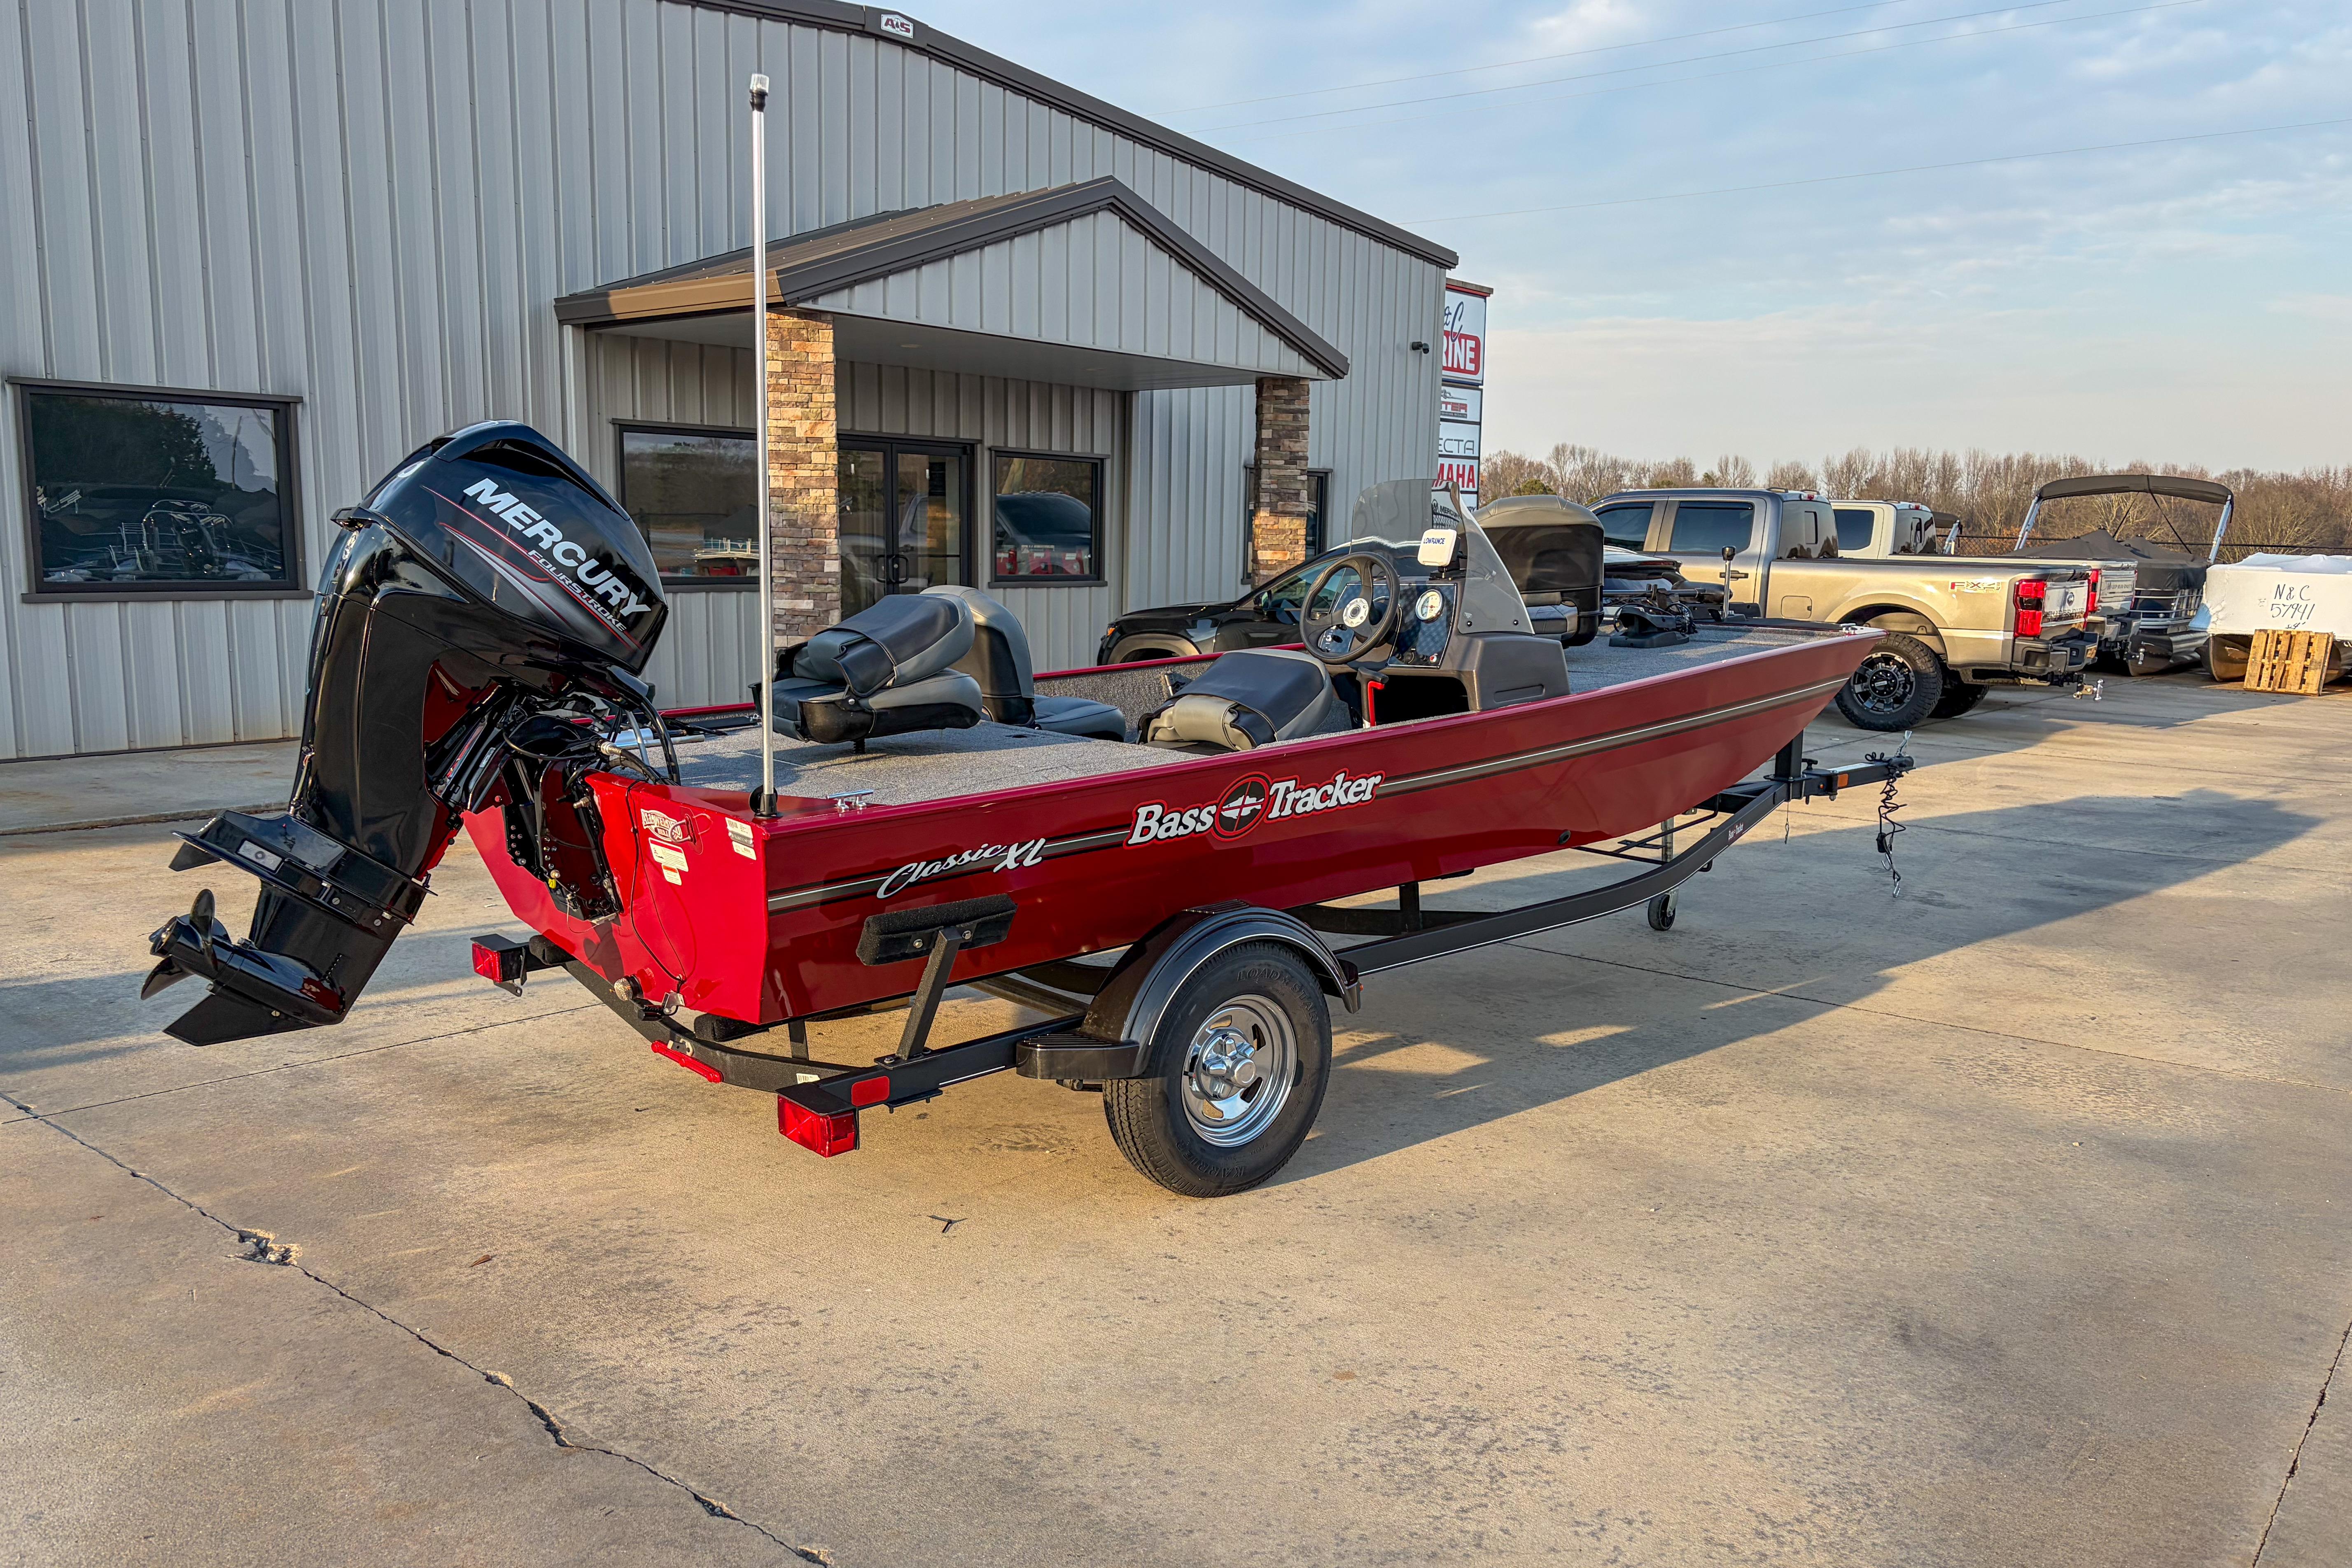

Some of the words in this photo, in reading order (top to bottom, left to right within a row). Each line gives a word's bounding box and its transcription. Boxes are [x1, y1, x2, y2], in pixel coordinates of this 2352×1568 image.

[1451, 301, 1464, 343] C
[463, 478, 651, 617] MERCURY
[528, 549, 627, 632] FOURSTROKE
[2270, 603, 2315, 620] 57941
[2274, 584, 2286, 599] N
[2286, 587, 2295, 600] &
[2300, 585, 2310, 601] C
[1128, 804, 1217, 845] Bass
[1268, 773, 1381, 819] Tracker
[876, 843, 1007, 899] Classic
[993, 838, 1046, 873] XL
[1237, 968, 1280, 982] LOAD
[1291, 983, 1318, 1024] STAR
